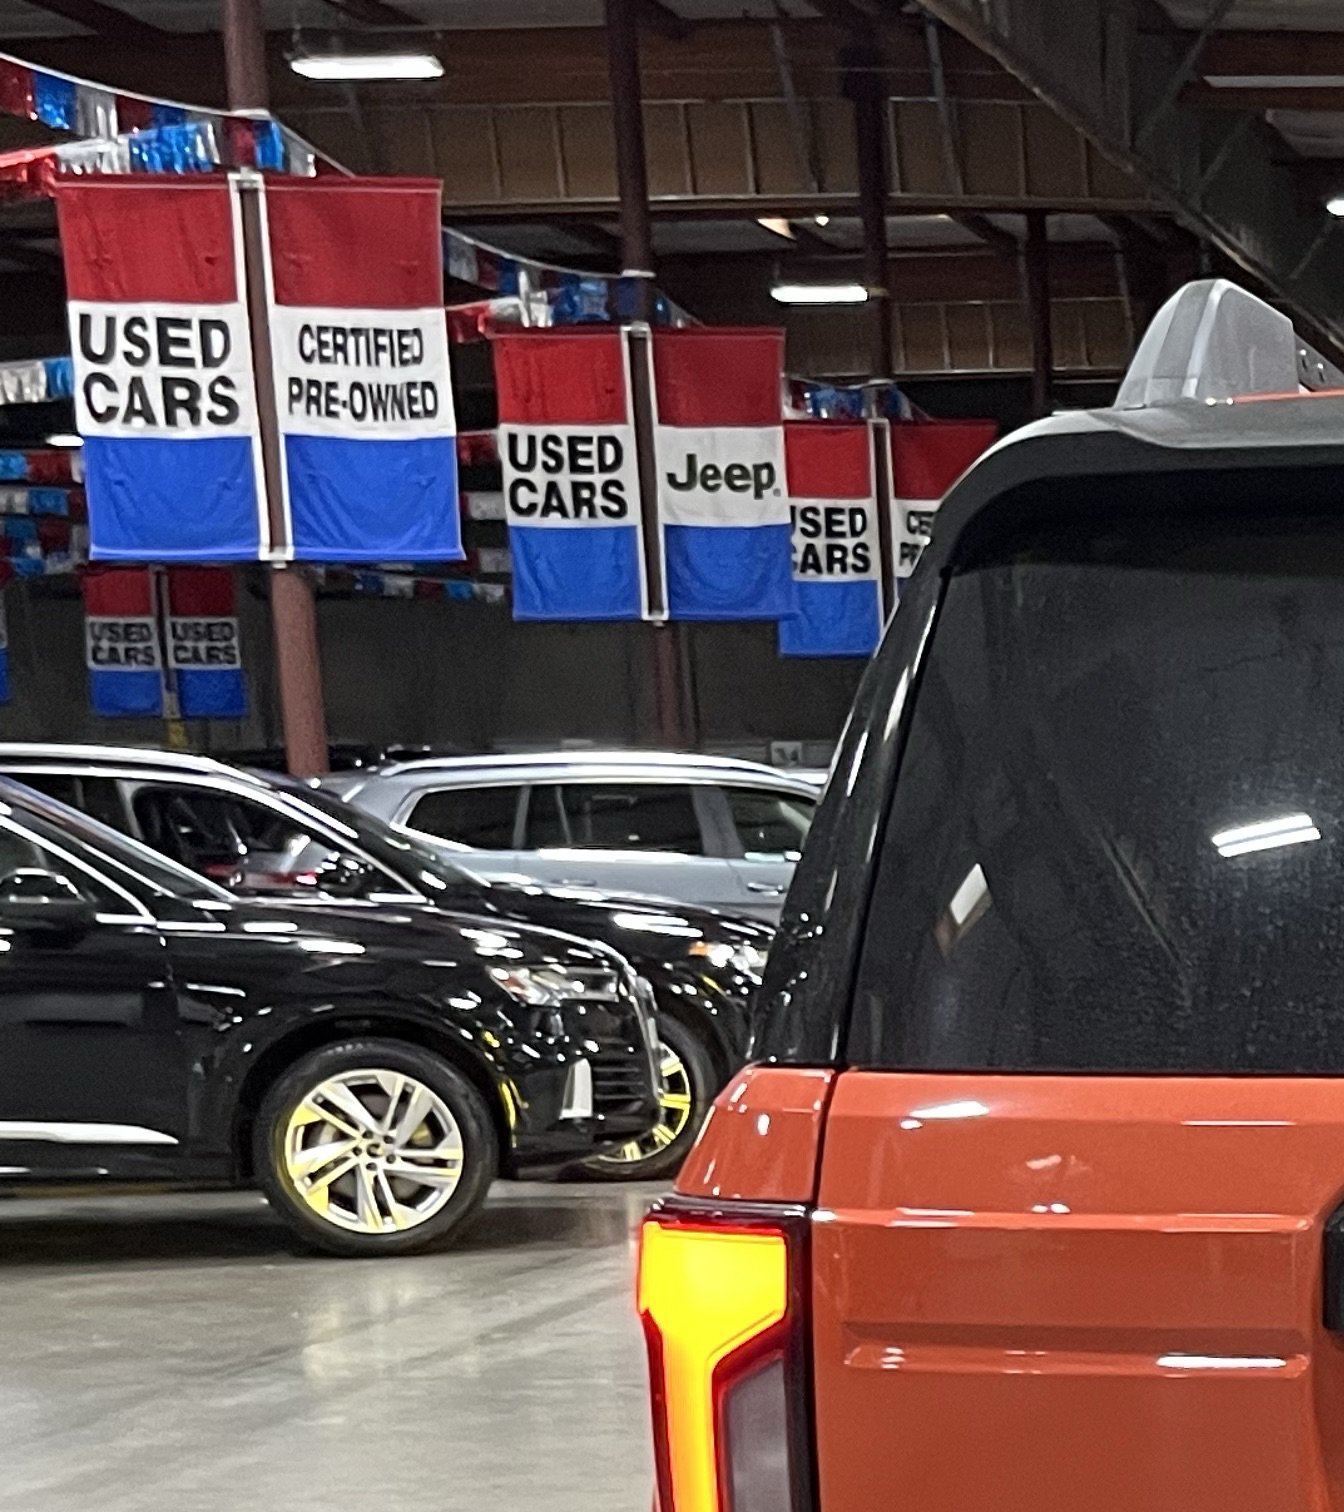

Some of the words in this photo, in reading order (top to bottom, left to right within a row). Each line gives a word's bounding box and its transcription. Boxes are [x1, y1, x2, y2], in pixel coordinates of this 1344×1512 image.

[79, 312, 232, 368] USED
[299, 324, 424, 367] CERTIFIED
[82, 372, 240, 427] CARS
[287, 377, 439, 422] PRE-OWNED
[507, 433, 624, 475] USED
[666, 453, 777, 500] Jeep
[509, 477, 628, 519] CARS
[792, 542, 871, 574] ARS
[89, 621, 152, 643] USED
[171, 621, 234, 643] USED
[92, 646, 155, 666] CARS
[173, 645, 237, 665] CARS
